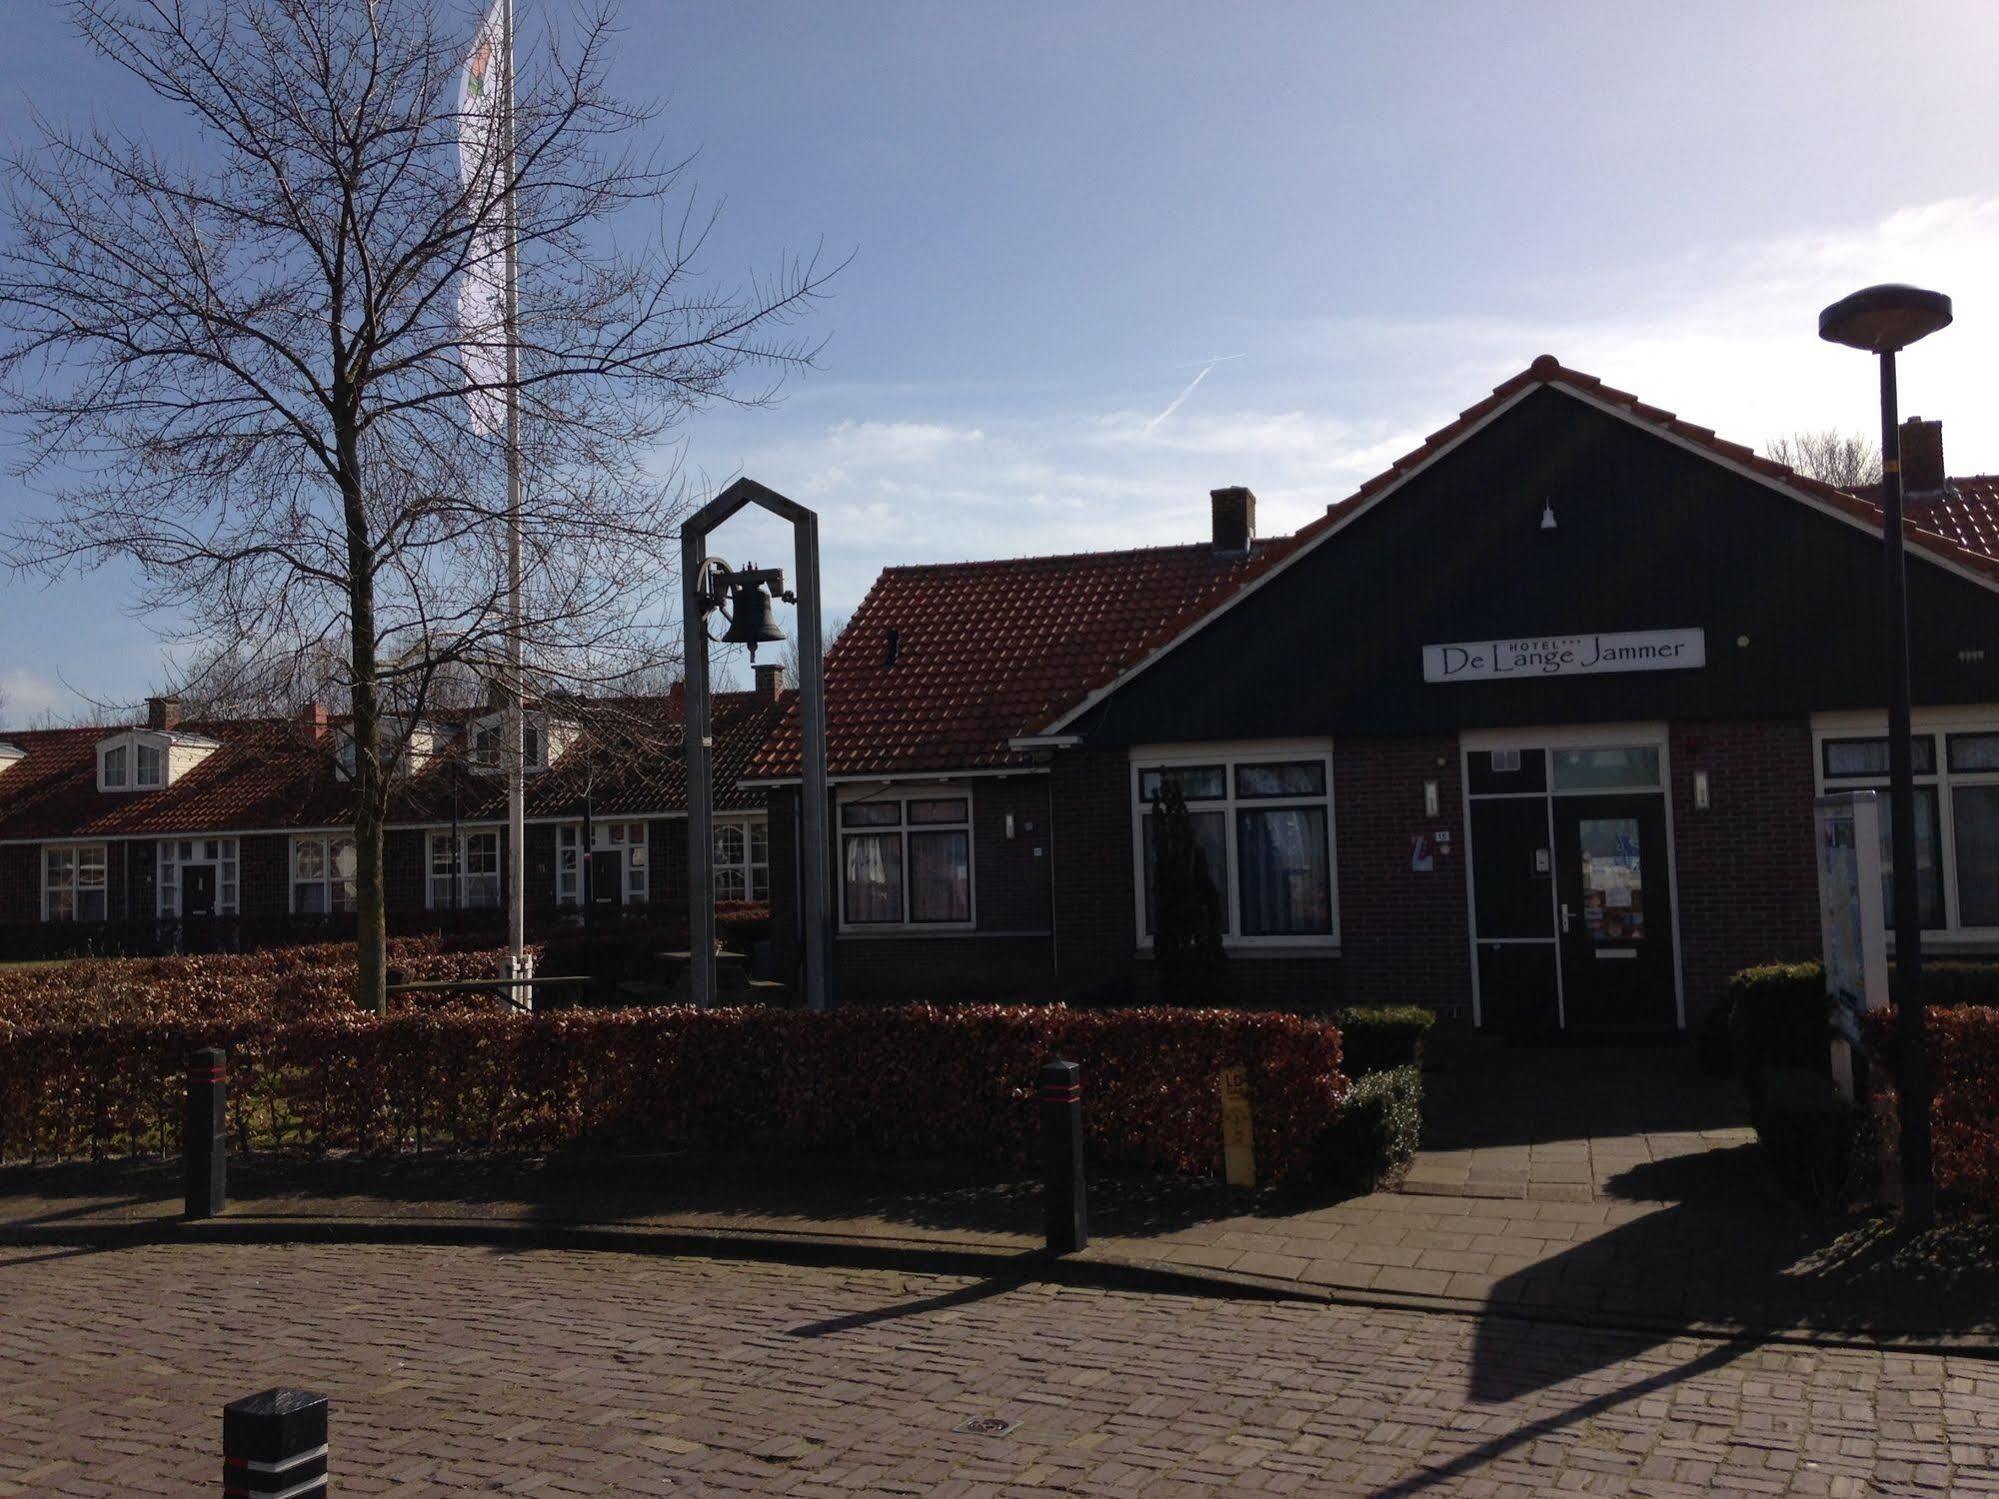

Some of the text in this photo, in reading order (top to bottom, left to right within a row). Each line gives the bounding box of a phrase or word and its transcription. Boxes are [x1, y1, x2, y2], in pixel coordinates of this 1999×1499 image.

[1442, 637, 1685, 675] De Lange Jammer
[1509, 640, 1559, 652] HOTEL
